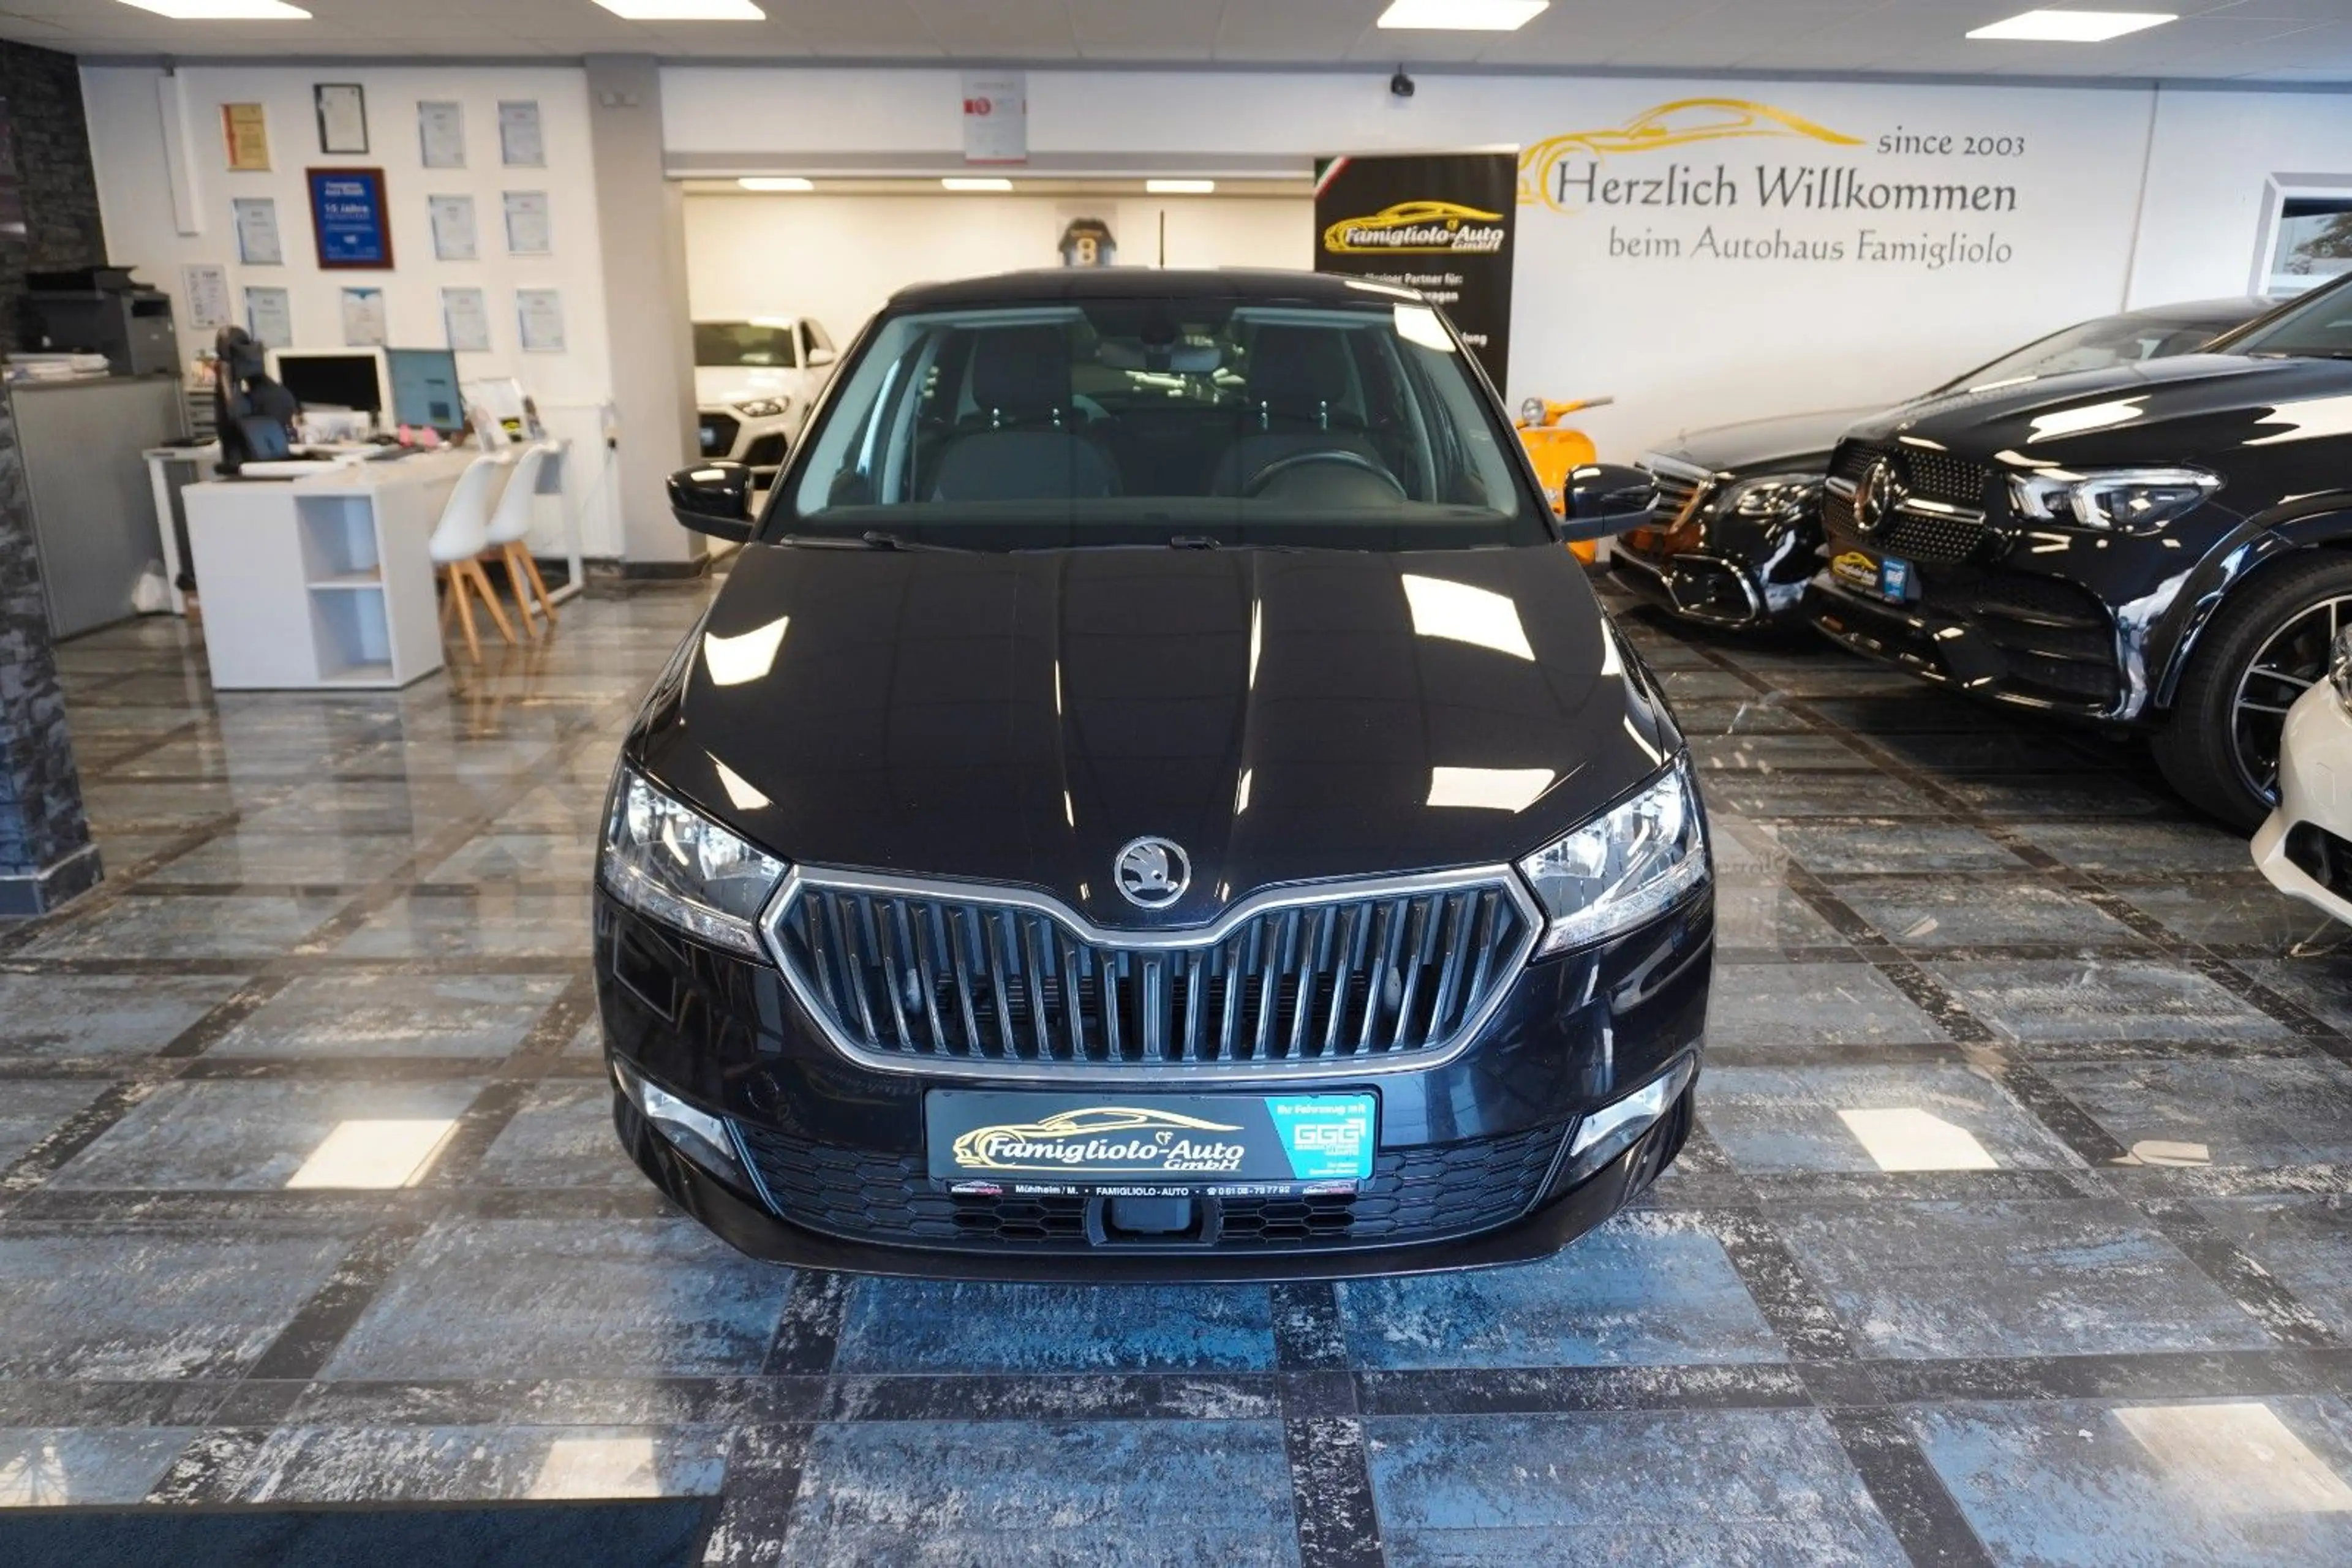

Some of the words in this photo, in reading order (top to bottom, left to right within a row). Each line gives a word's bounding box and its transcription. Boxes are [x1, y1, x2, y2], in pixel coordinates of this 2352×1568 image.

[1877, 124, 1953, 155] since
[1962, 135, 2025, 157] 2003
[1556, 160, 1738, 207] Herzlich
[1755, 164, 2018, 211] Willkommen
[1345, 225, 1504, 246] Famigliolo-Auto
[1608, 225, 1681, 258] beim
[1689, 225, 1844, 260] Autohaus
[1857, 228, 2012, 270] Famigliolo
[1404, 273, 1443, 284] Partner
[1294, 1121, 1362, 1144] GGG
[987, 1136, 1245, 1164] Famigliolo-Auto
[1163, 1158, 1241, 1171] GmbH
